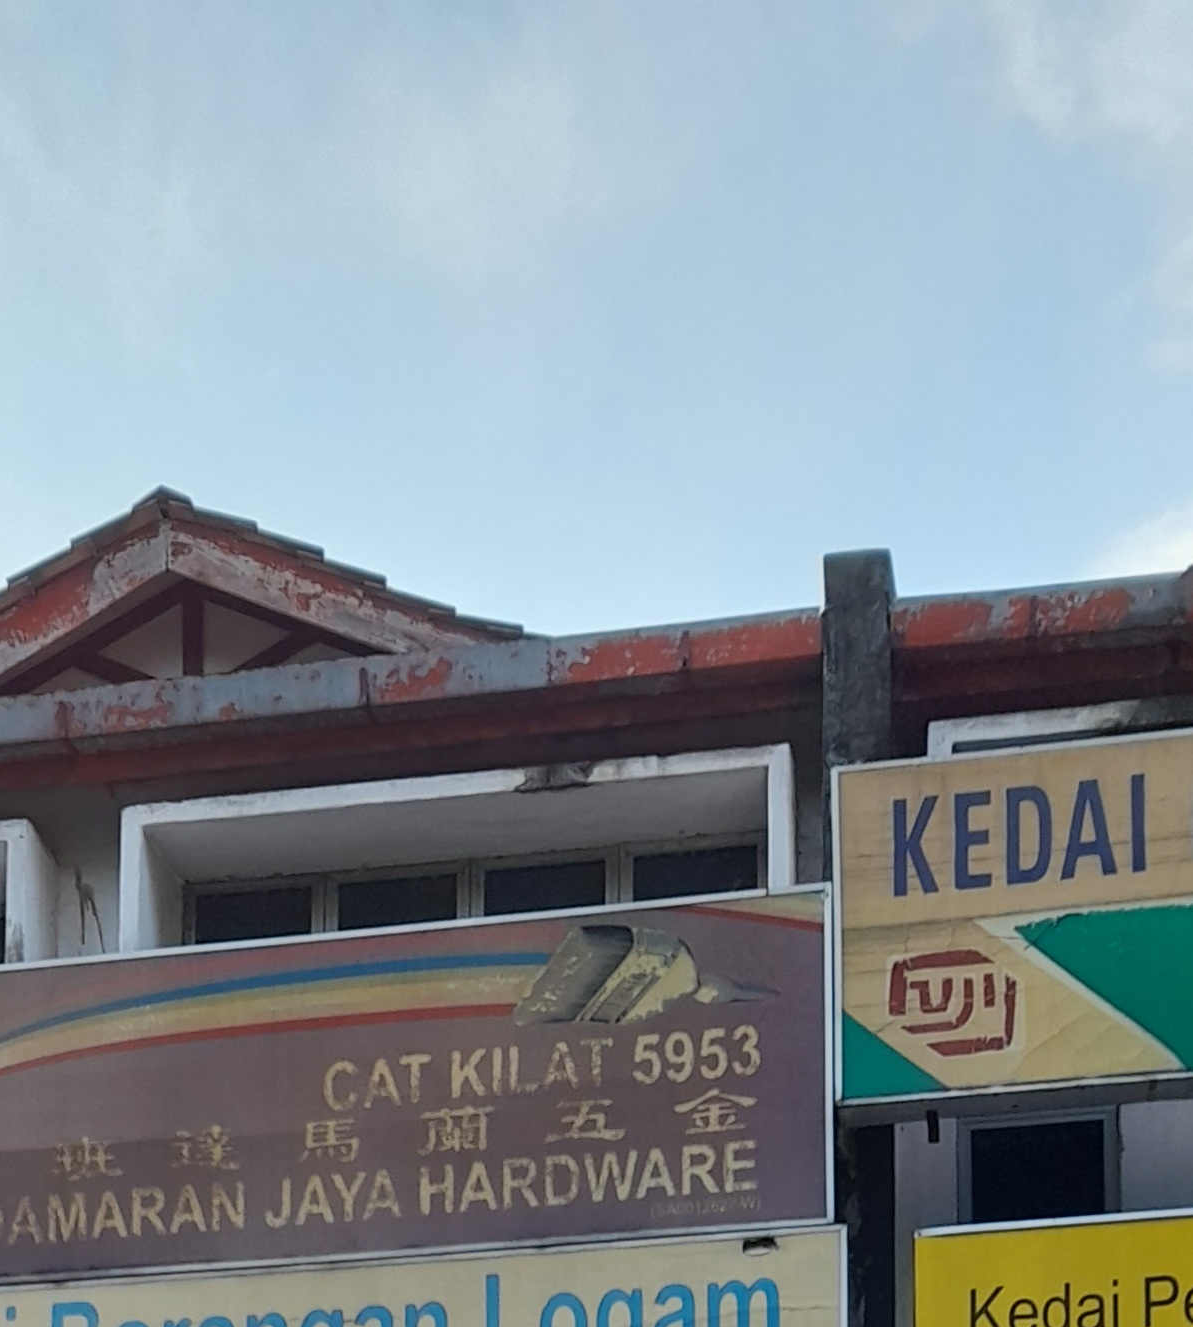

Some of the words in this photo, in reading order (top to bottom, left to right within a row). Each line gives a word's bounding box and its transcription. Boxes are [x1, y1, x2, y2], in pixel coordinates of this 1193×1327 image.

[893, 773, 1147, 897] KEDAI
[323, 1053, 432, 1112] CAT
[451, 1037, 615, 1100] KILAT
[632, 1025, 762, 1086] 5953
[264, 1167, 402, 1230] JAYA
[418, 1140, 756, 1216] HARDWARE
